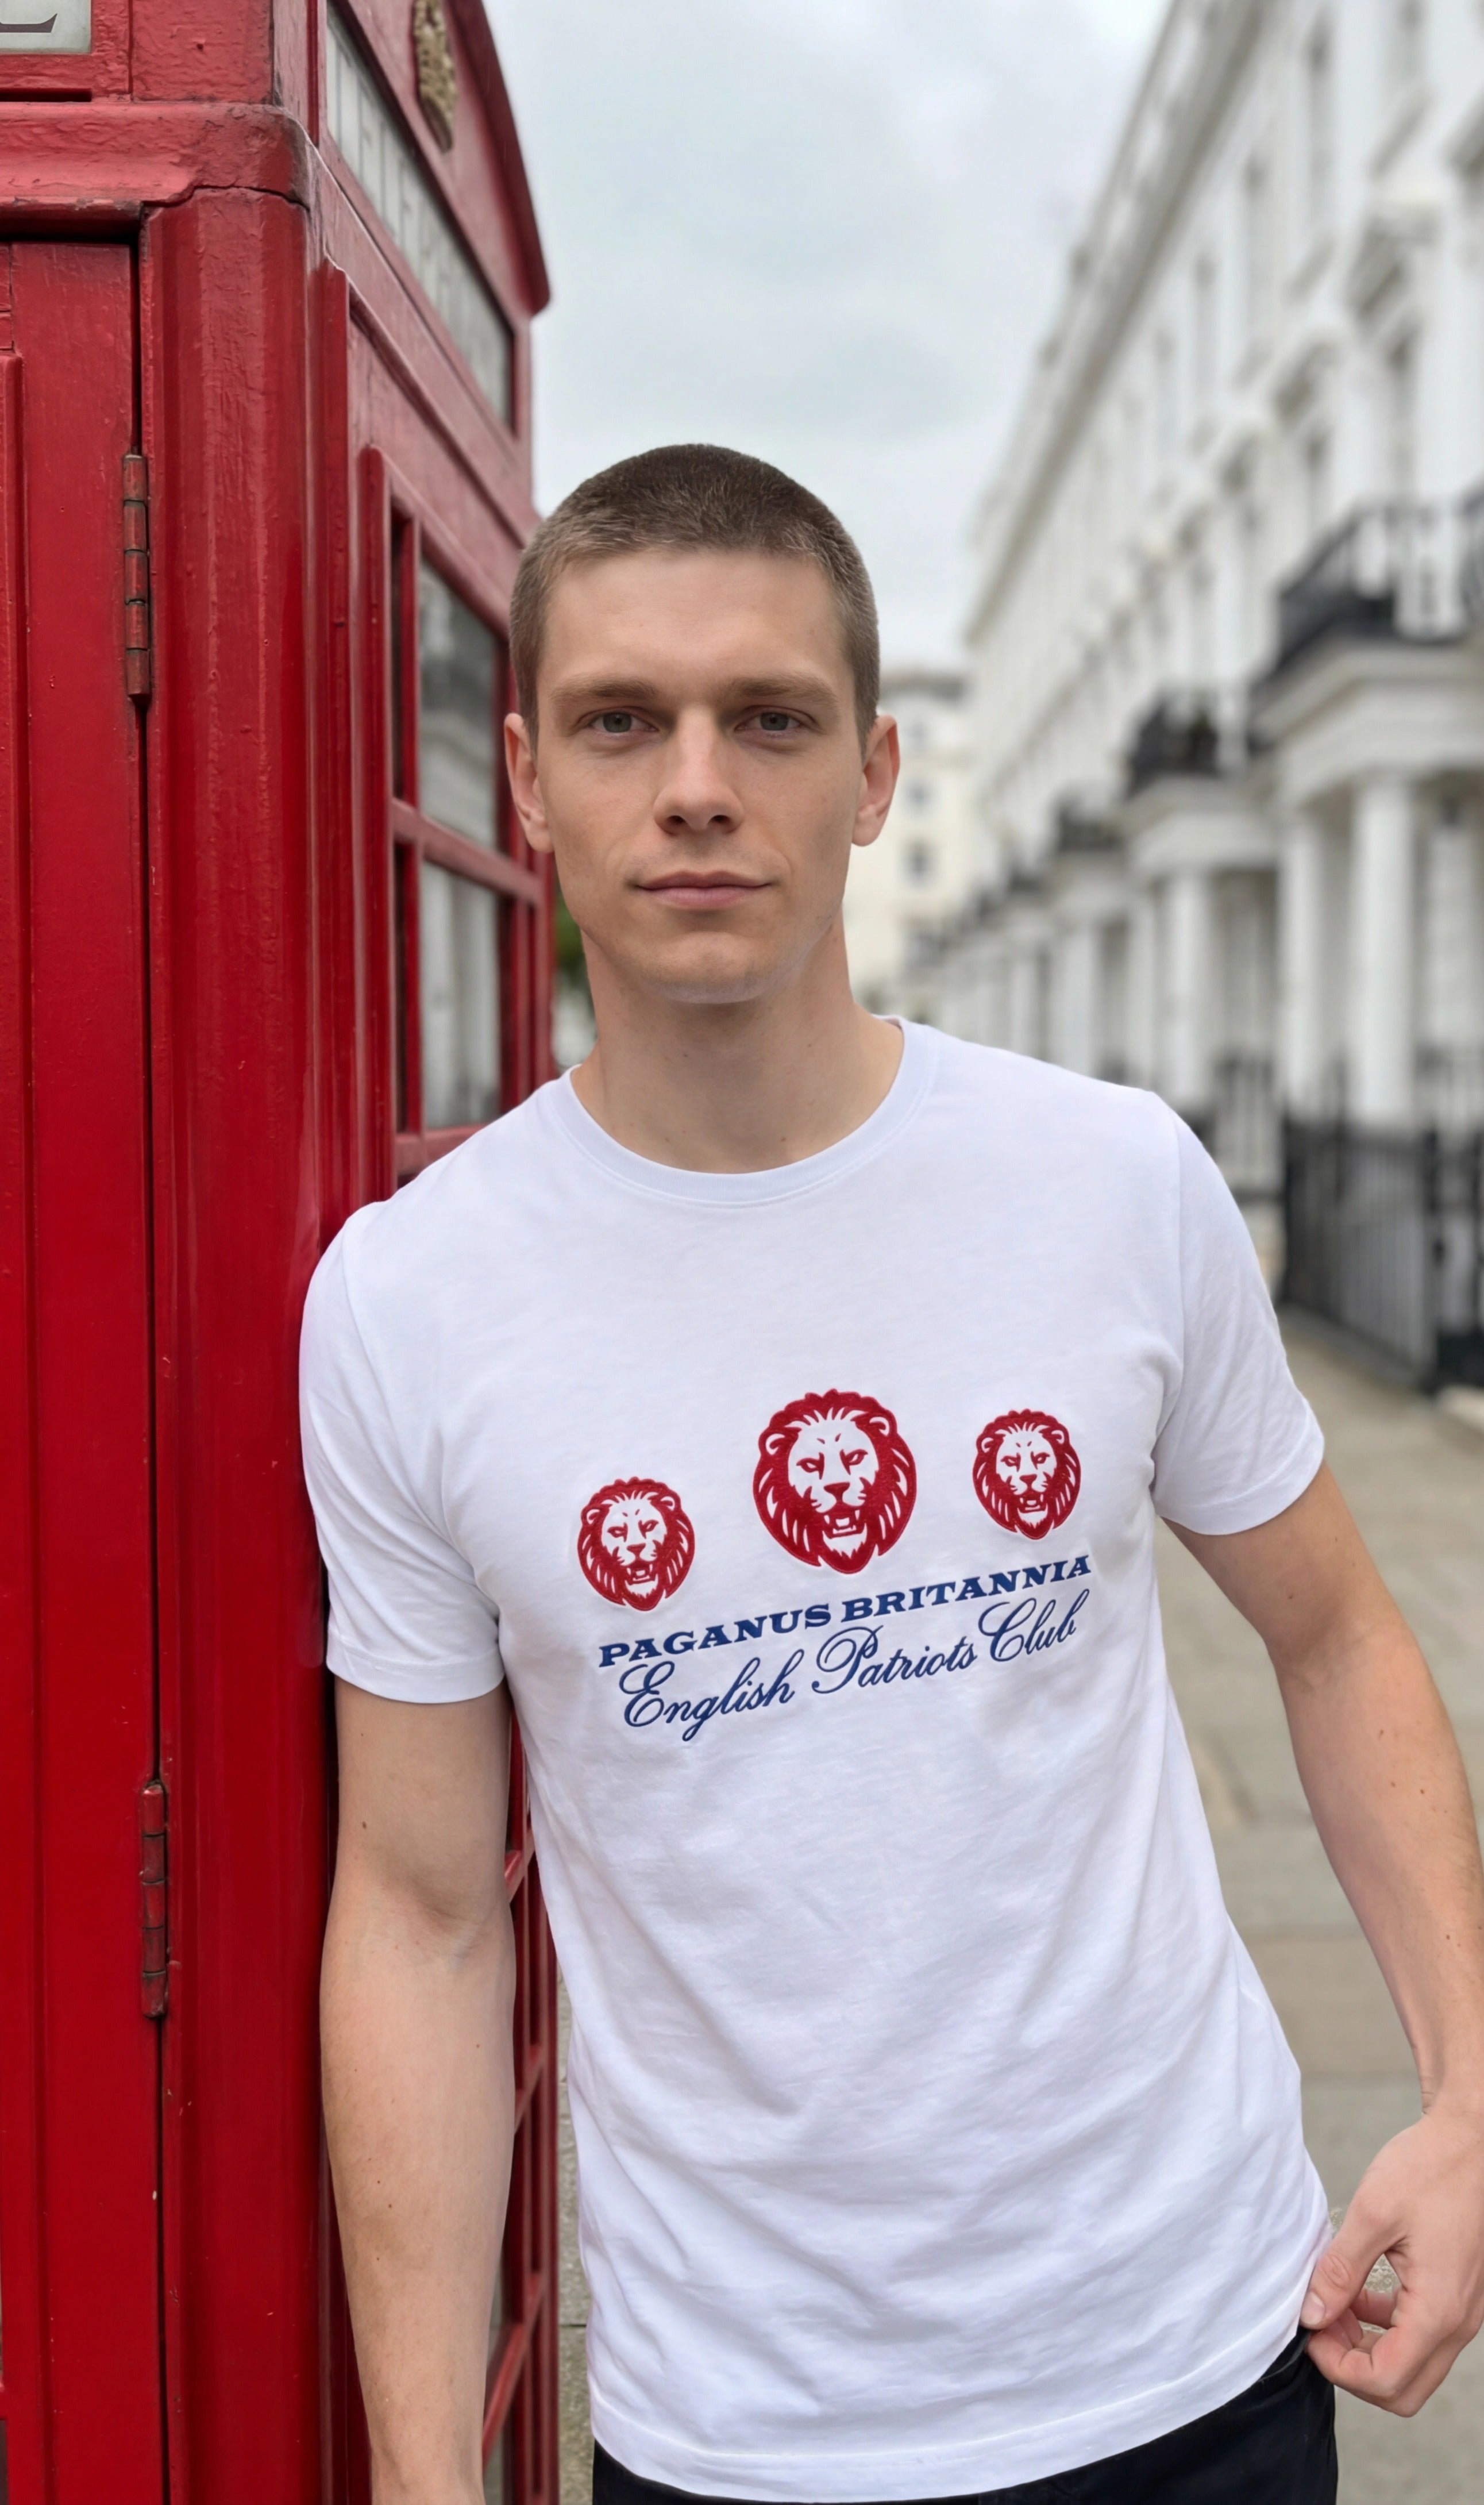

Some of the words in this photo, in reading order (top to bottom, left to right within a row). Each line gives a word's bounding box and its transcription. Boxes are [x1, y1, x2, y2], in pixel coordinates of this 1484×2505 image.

[599, 1603, 832, 1668] PAGANUS
[840, 1555, 1091, 1623] BRITANNIA
[619, 1649, 805, 1742] English
[811, 1625, 978, 1695] Patriots
[977, 1588, 1090, 1663] Club
